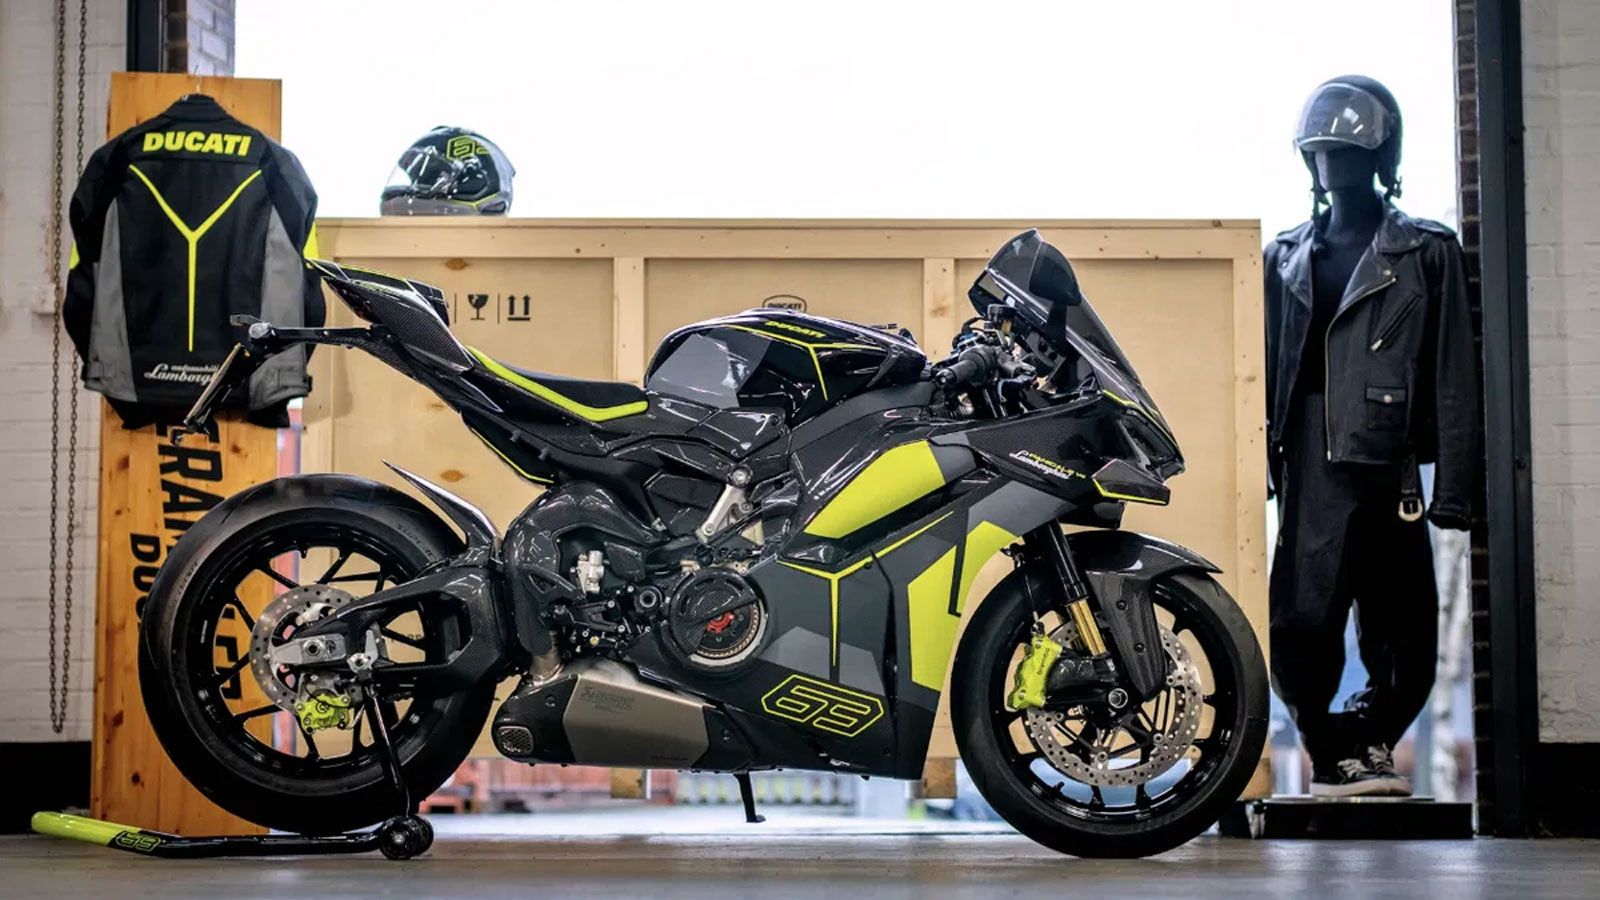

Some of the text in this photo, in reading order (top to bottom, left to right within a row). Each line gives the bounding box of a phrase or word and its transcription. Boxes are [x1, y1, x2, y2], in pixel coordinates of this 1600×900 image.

[142, 131, 252, 156] DUCATI
[765, 321, 827, 338] DUCATI
[143, 363, 212, 386] Lamborg
[1009, 450, 1071, 480] Lamborghini
[761, 674, 884, 736] 63
